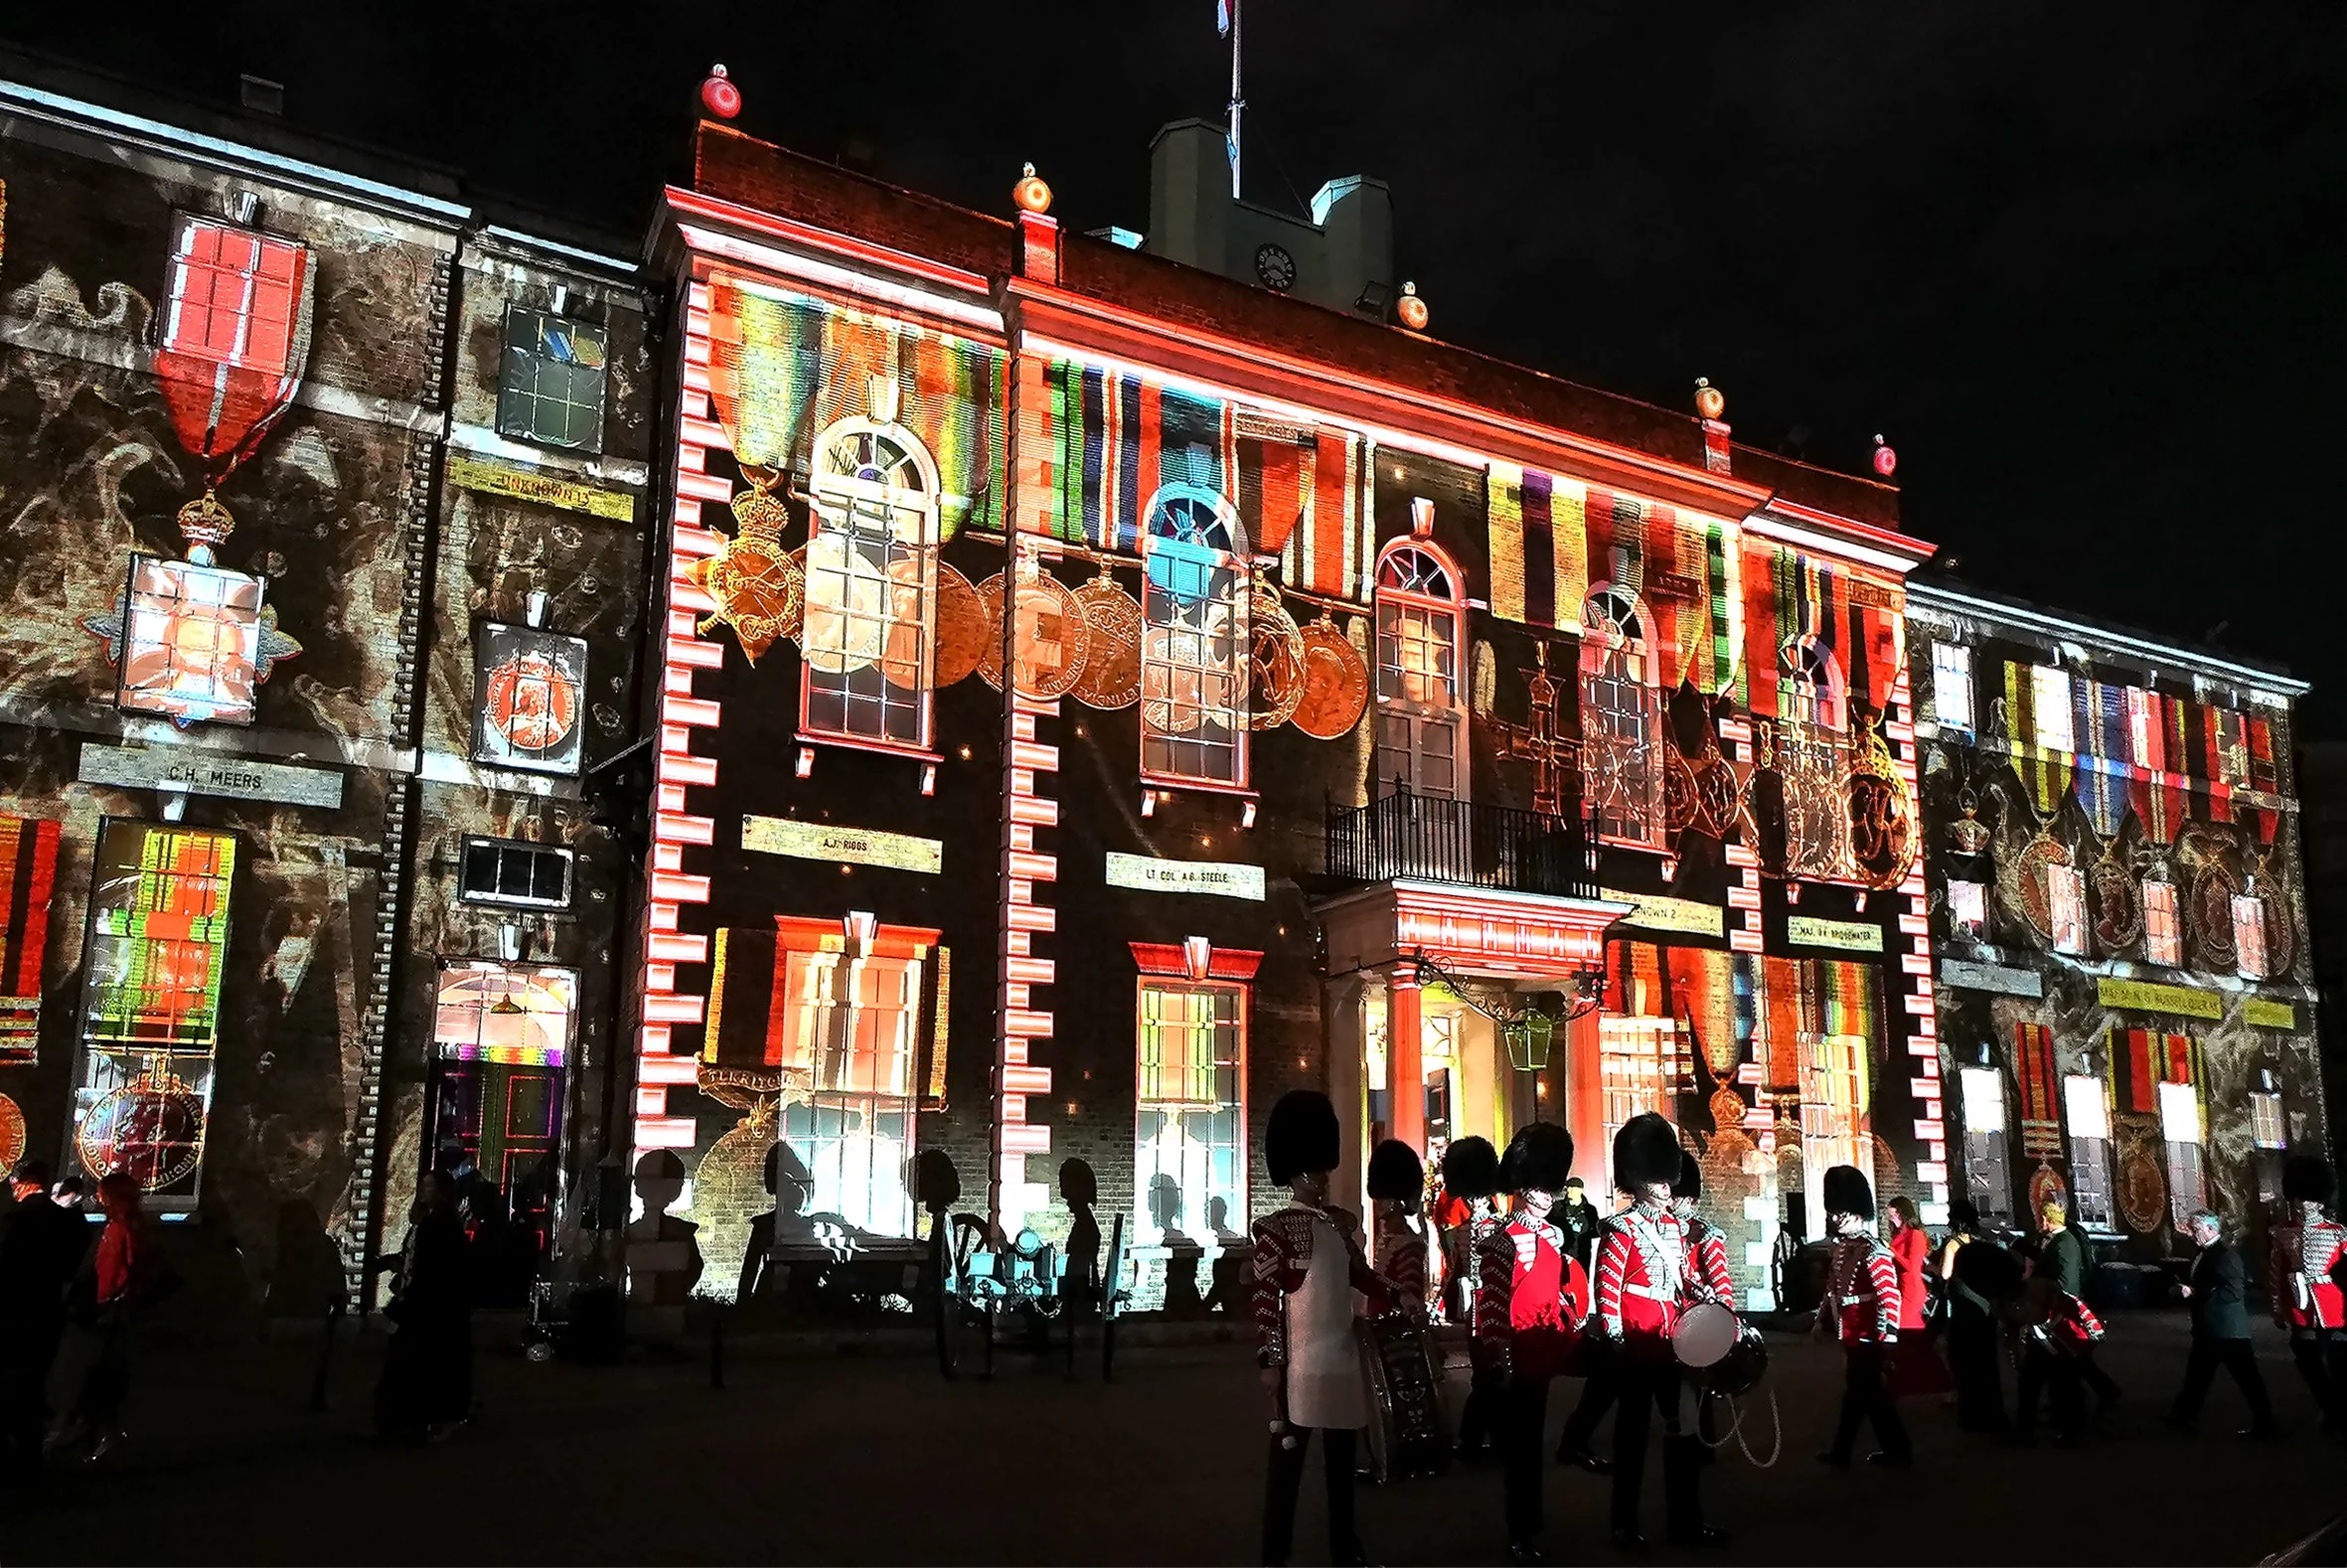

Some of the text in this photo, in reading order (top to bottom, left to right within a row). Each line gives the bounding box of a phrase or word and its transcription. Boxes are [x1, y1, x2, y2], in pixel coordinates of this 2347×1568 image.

[169, 766, 262, 788] C.H. MEERS
[843, 840, 867, 851] RIGGS
[1200, 871, 1229, 883] STEELE
[1670, 909, 1676, 919] 2
